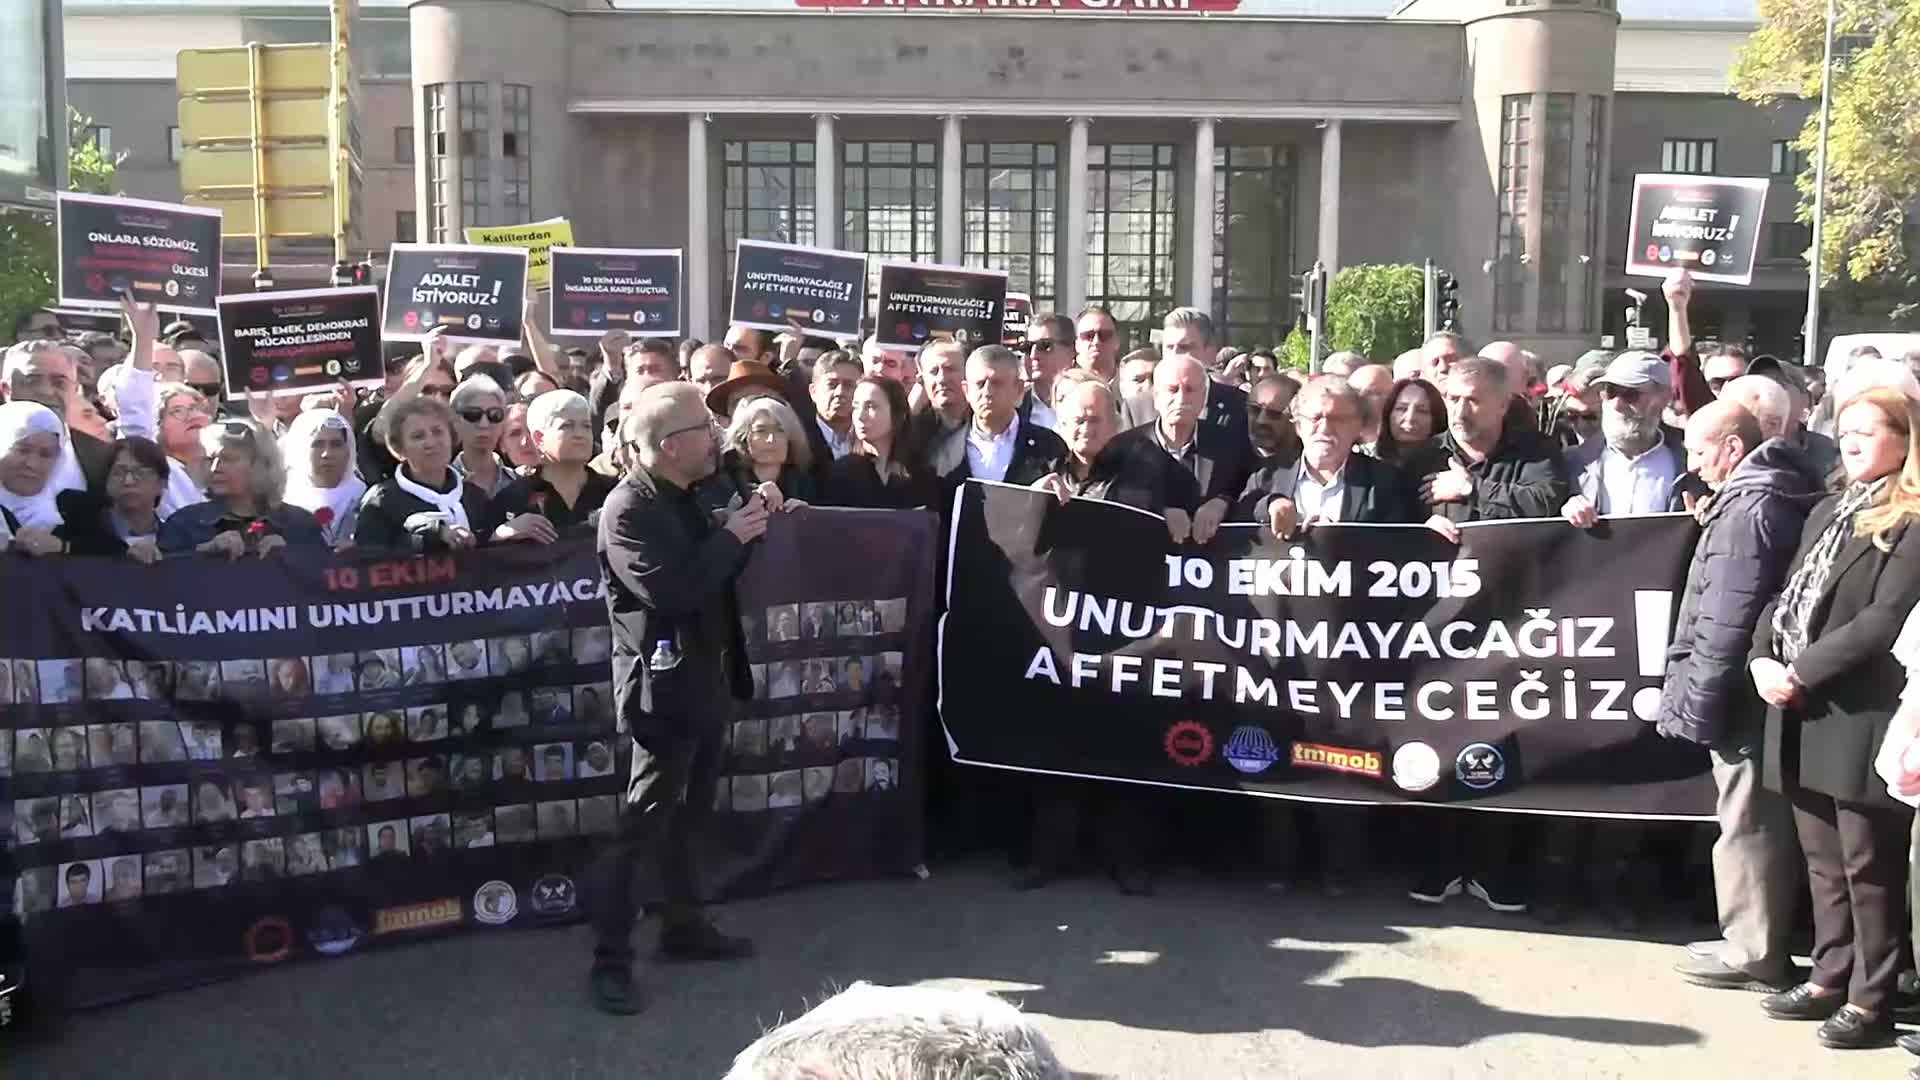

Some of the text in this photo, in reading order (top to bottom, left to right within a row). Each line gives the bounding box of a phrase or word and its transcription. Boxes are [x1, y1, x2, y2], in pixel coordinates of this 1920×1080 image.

[88, 232, 141, 246] ONLARA
[419, 273, 481, 288] ADALET
[307, 317, 369, 332] DEMOKRASİ
[324, 557, 457, 591] 10 EKİM
[1165, 546, 1482, 599] 10 EKİM 2015
[81, 577, 609, 635] KATLİAMINI UNUTTURMAYAC
[1042, 586, 1616, 660] UNUTTURMAYACAĞIZ
[1222, 743, 1279, 762] KESK
[1295, 743, 1379, 771] tmmob
